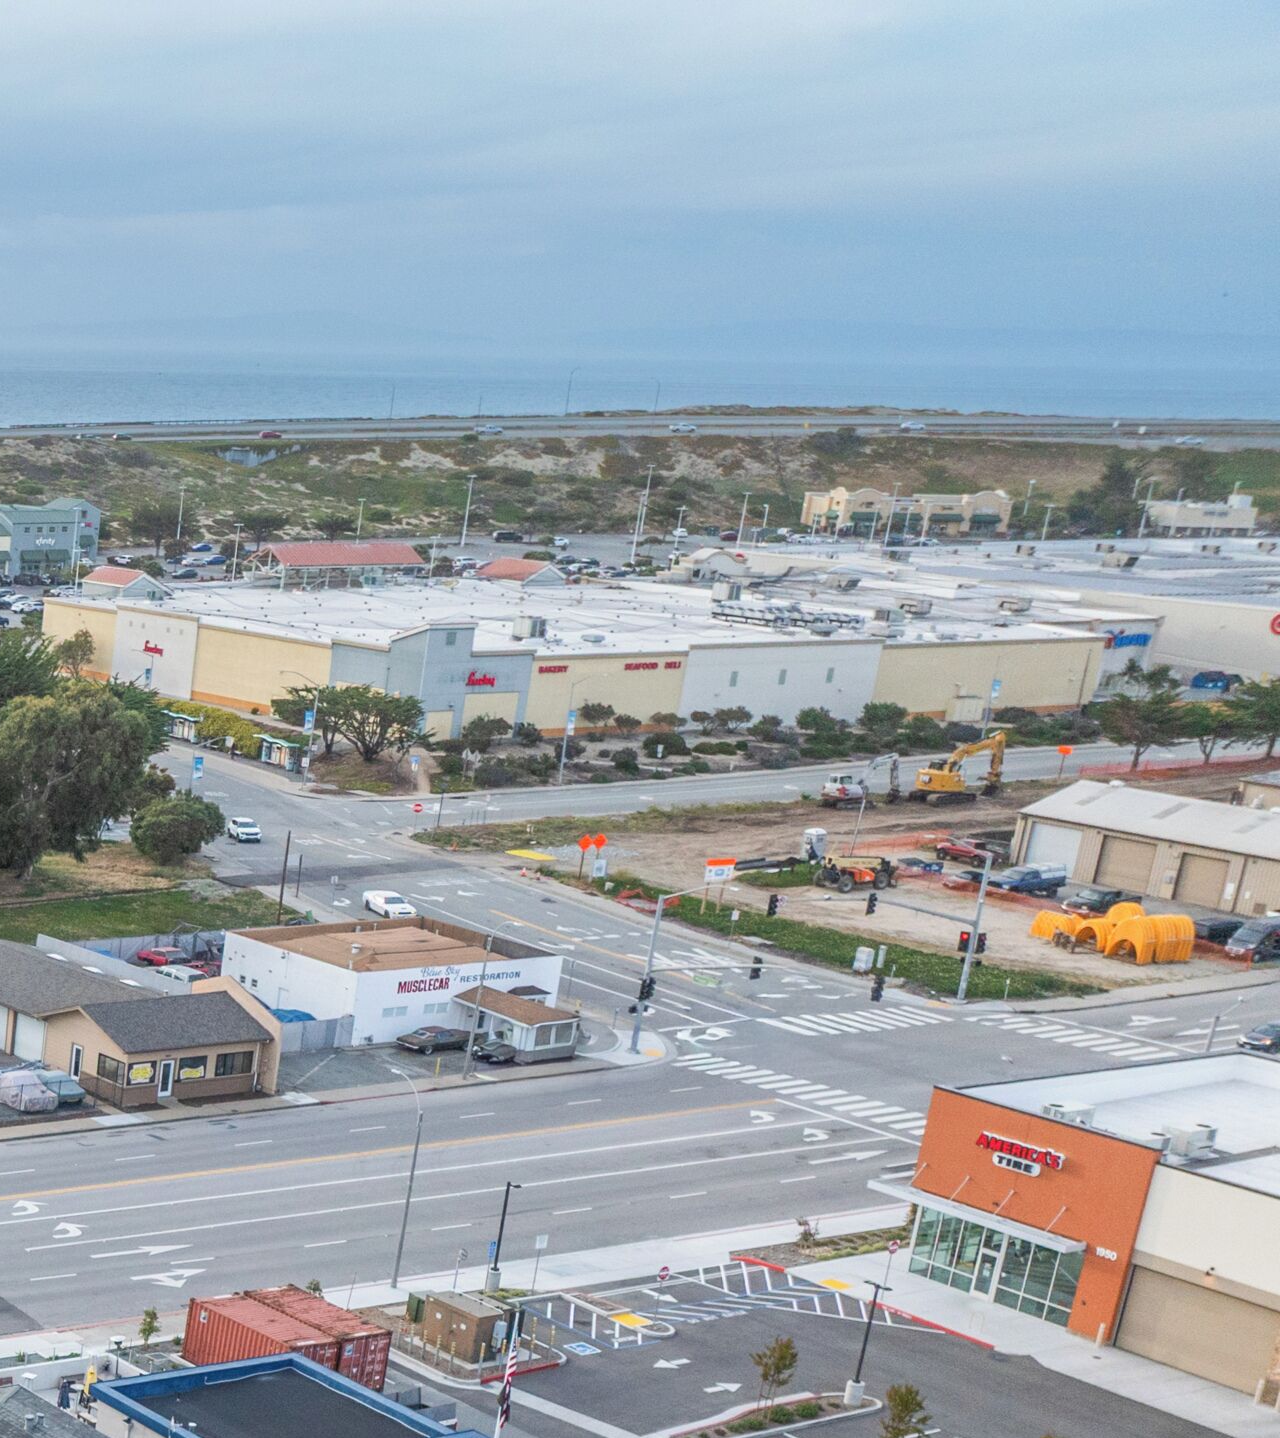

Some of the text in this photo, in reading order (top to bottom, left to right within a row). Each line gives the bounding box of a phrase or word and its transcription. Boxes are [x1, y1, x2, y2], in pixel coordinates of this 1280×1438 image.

[35, 537, 56, 546] xfinity
[538, 661, 681, 674] BAKERY SEAFOOD DELI
[420, 966, 461, 981] Blue Sky
[397, 970, 521, 994] MUSCLECAR RESTORATION
[976, 1131, 1063, 1170] AMERICA'S
[996, 1154, 1034, 1173] TIRE
[1096, 1246, 1118, 1261] 1950
